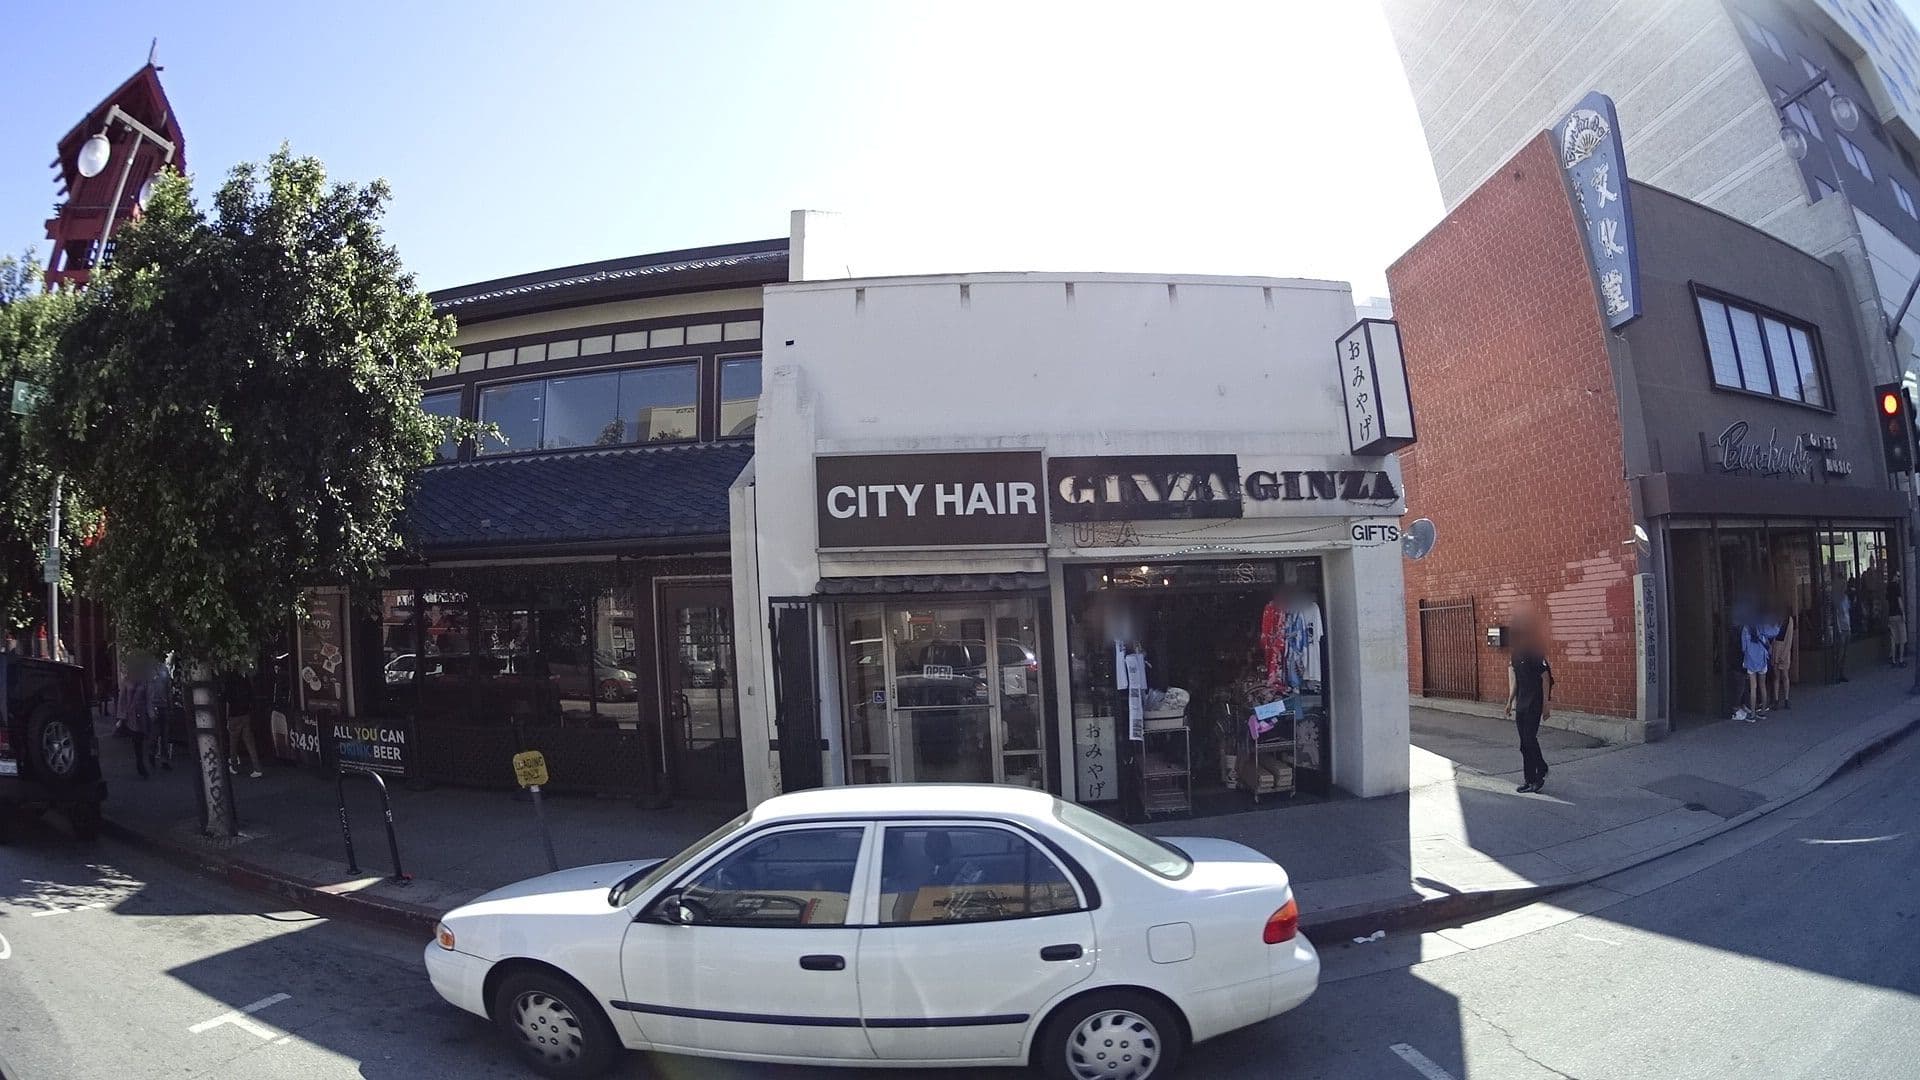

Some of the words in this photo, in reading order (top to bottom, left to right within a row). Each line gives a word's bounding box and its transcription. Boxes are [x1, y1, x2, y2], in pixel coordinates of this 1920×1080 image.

[1348, 340, 1372, 441] おみやげ
[1825, 458, 1852, 474] MUSIC
[1245, 470, 1400, 501] GINZA
[826, 484, 925, 519] CITY
[935, 482, 1037, 516] HAIR
[1351, 524, 1399, 541] GIFTS
[925, 664, 952, 679] OPEN
[333, 725, 353, 739] ALL
[354, 727, 378, 741] YOU
[380, 729, 405, 744] CAN
[340, 742, 370, 757] DRINK
[373, 745, 402, 760] BEER
[1085, 722, 1106, 799] おみやげ
